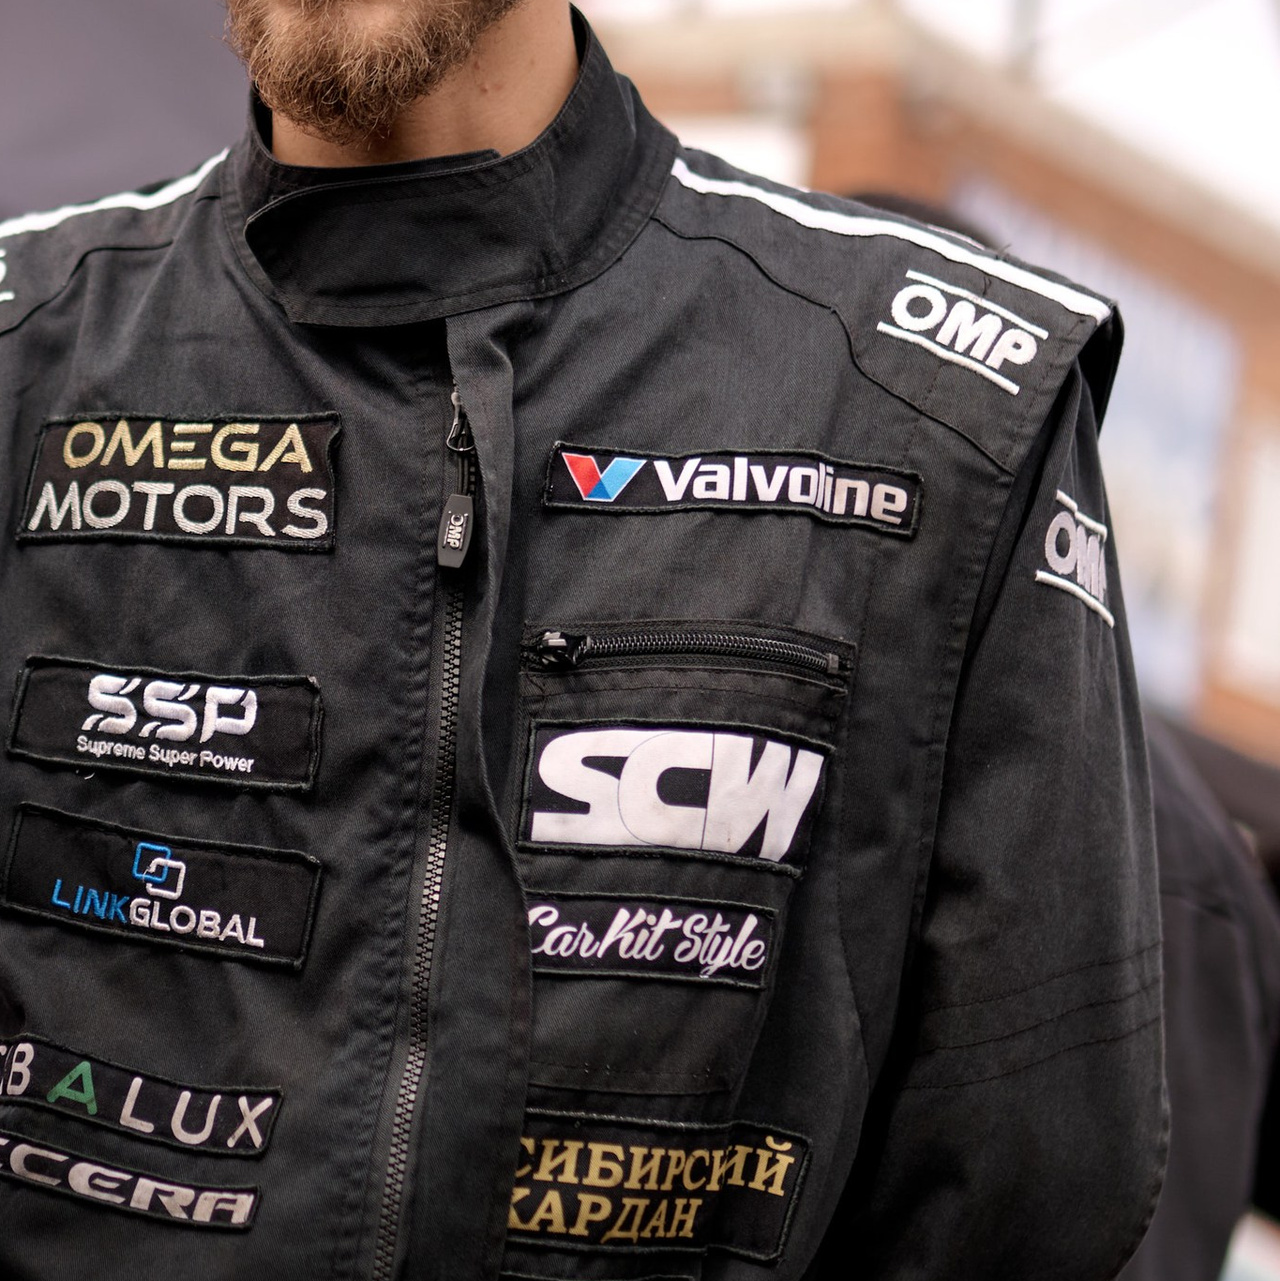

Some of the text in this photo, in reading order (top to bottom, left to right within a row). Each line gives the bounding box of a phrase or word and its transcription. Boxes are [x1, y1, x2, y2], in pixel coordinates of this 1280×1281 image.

[890, 283, 1039, 370] OMP
[62, 420, 313, 472] OMEGA
[28, 480, 328, 539] MOTORS
[654, 458, 908, 525] Valvoline
[447, 514, 464, 549] OMP
[1045, 511, 1107, 603] OM
[81, 674, 258, 743] SSP
[76, 735, 255, 773] Supreme Super Power
[531, 729, 824, 862] SCW
[674, 913, 766, 979] Style
[507, 1186, 703, 1244] КАРДАН
